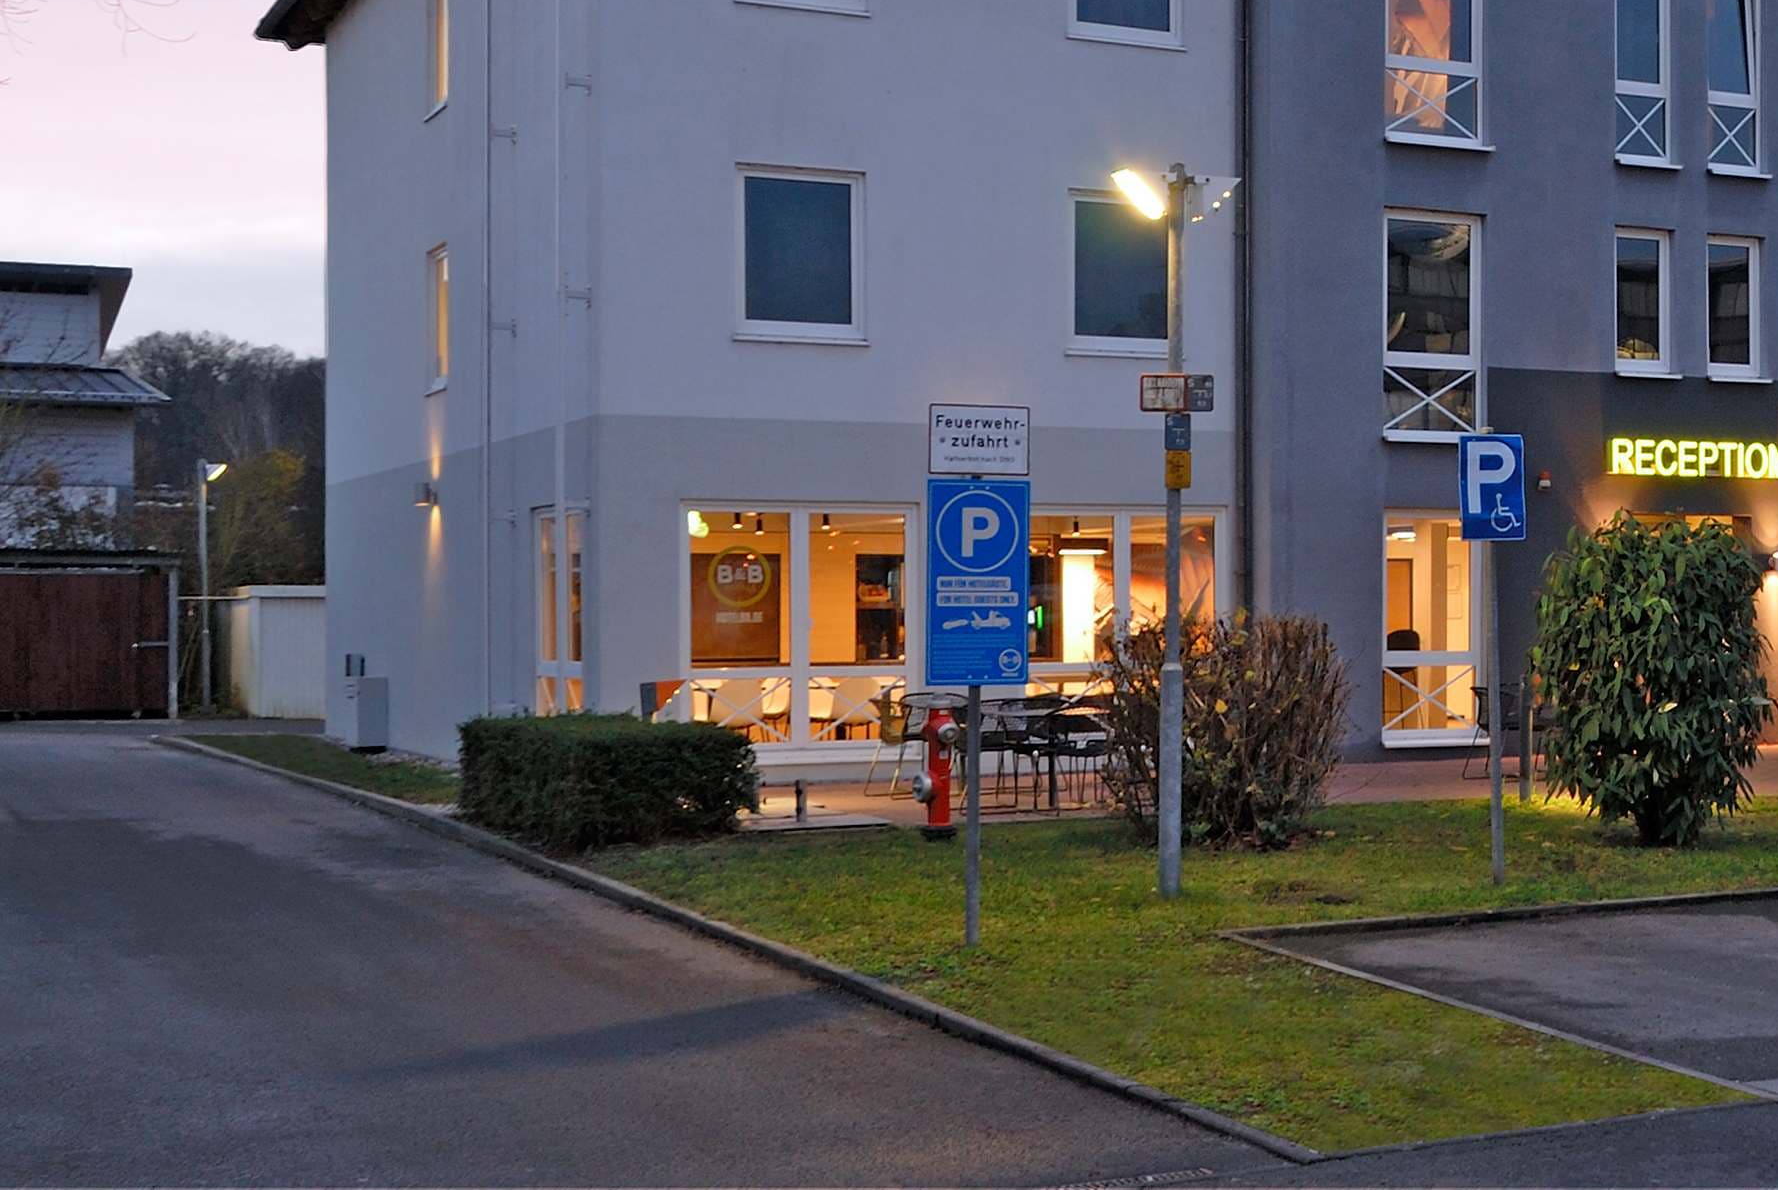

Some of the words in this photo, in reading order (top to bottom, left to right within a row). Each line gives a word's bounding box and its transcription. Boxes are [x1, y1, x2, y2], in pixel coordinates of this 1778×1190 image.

[935, 414, 1026, 430] Feuerwehr-
[951, 434, 1009, 448] zufahrt
[1466, 440, 1516, 514] P
[961, 507, 1000, 558] P
